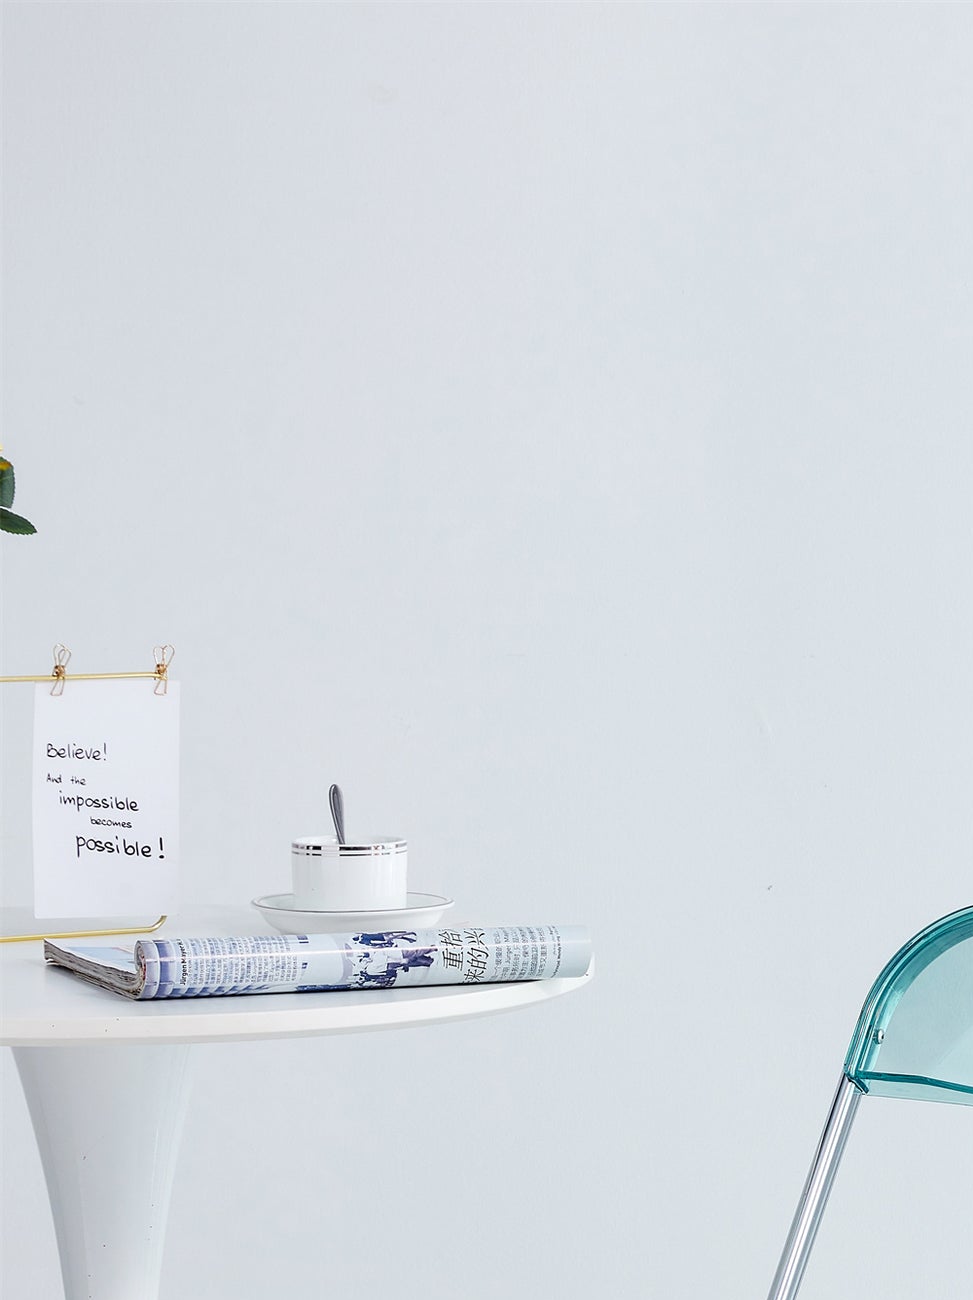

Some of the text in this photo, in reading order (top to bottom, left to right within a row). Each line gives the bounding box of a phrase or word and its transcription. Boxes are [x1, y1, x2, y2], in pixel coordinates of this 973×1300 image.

[46, 742, 107, 761] Believe!
[46, 773, 87, 786] And the
[58, 790, 140, 812] impossible
[90, 816, 133, 829] becomes
[438, 929, 464, 971] 重拾
[463, 928, 489, 982] 来的兴
